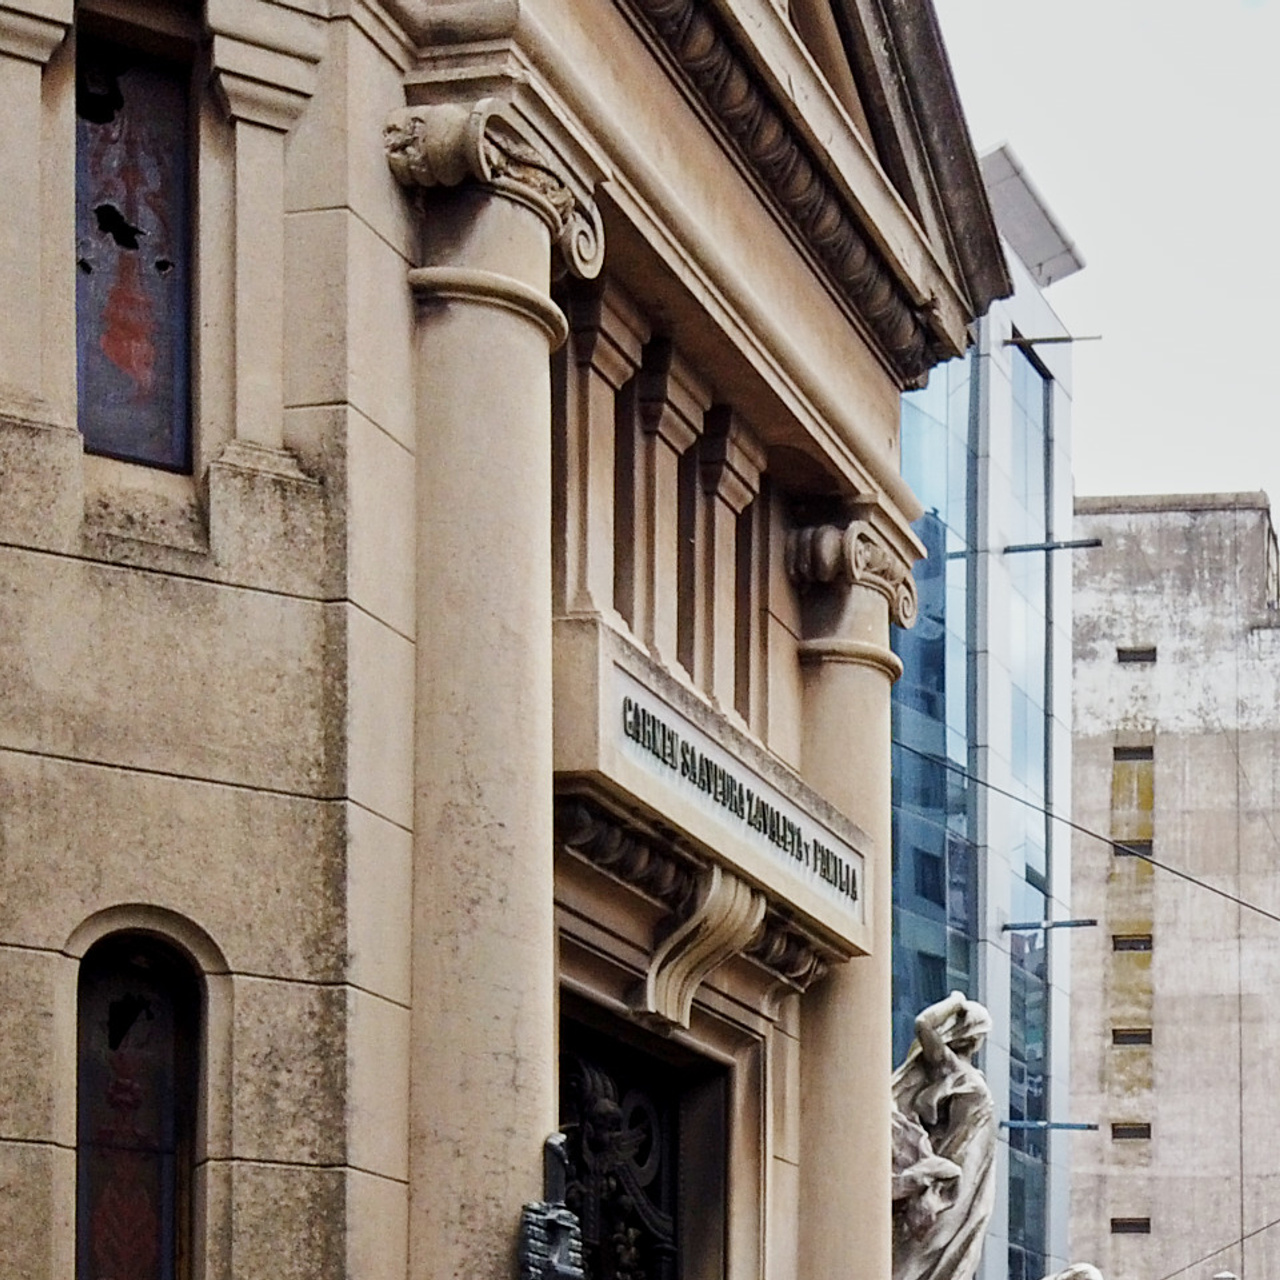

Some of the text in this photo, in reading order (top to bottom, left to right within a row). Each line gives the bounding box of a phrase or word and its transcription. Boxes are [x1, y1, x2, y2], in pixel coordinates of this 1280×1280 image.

[681, 740, 745, 820] SAAVEDRA
[746, 788, 804, 862] ZAVALETA
[812, 838, 859, 902] FAMILIA
